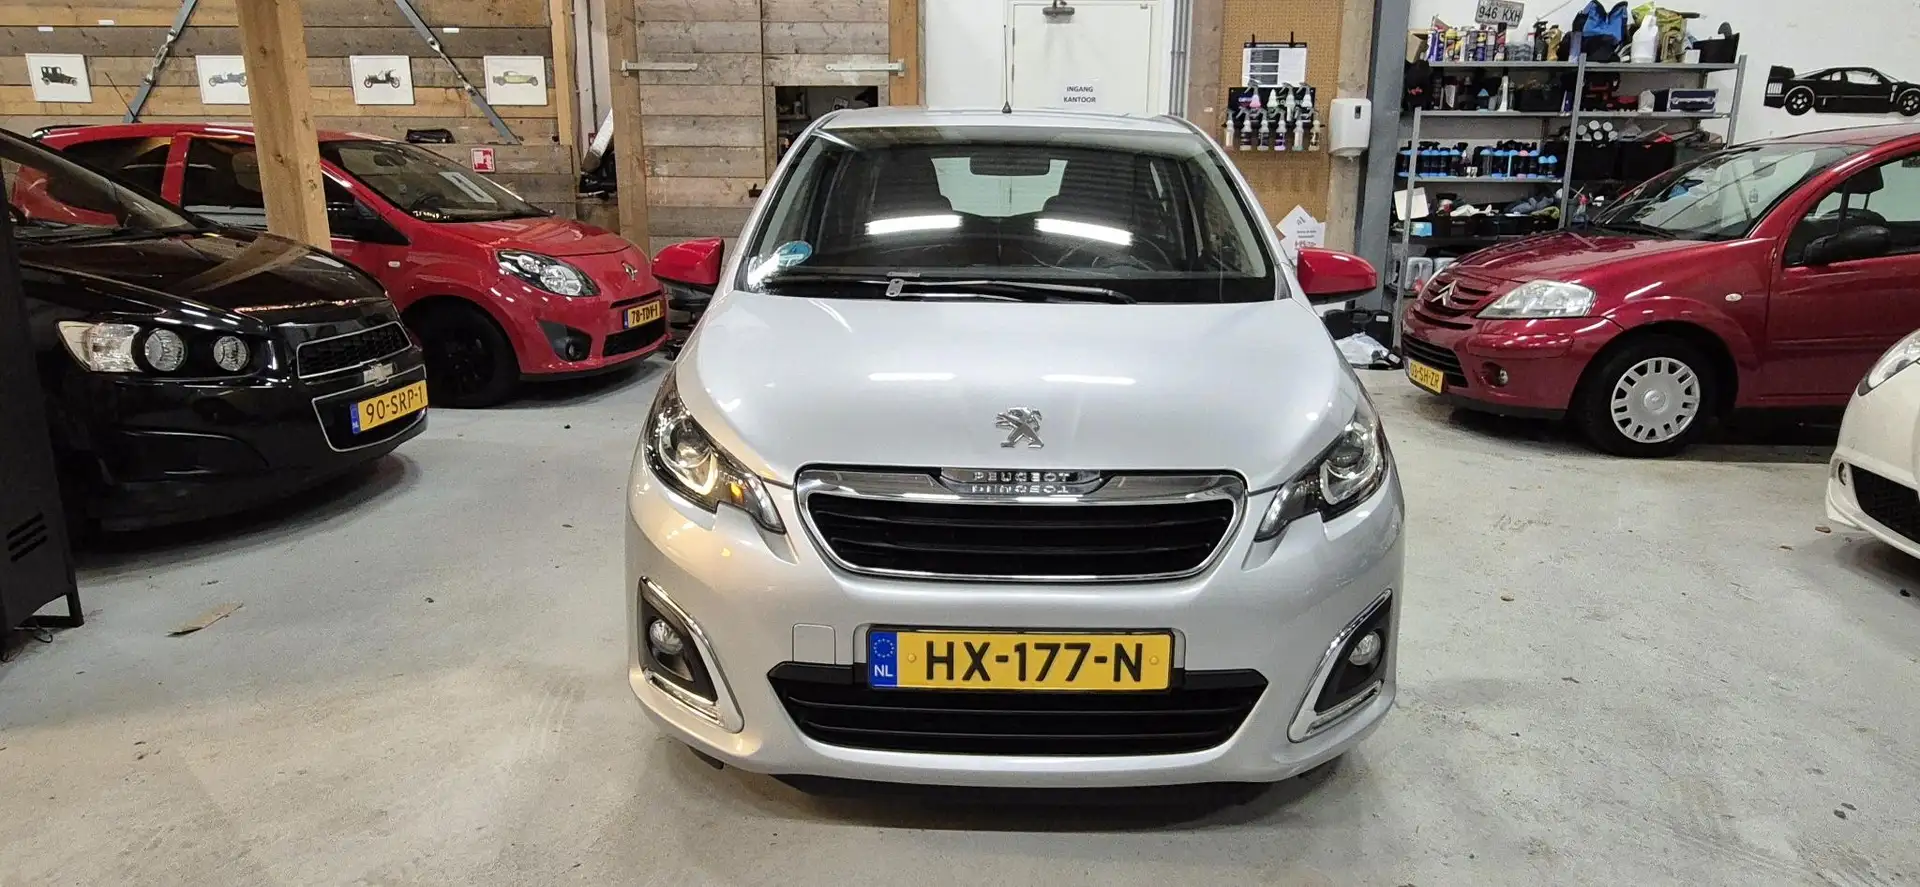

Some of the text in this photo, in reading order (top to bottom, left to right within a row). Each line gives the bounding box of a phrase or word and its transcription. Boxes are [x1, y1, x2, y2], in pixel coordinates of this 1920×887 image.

[1478, 6, 1521, 22] 946 KXH
[365, 386, 423, 424] 90-SRP-1
[973, 471, 1070, 483] PEUGEOT
[874, 640, 1144, 683] NL HX-177-N
